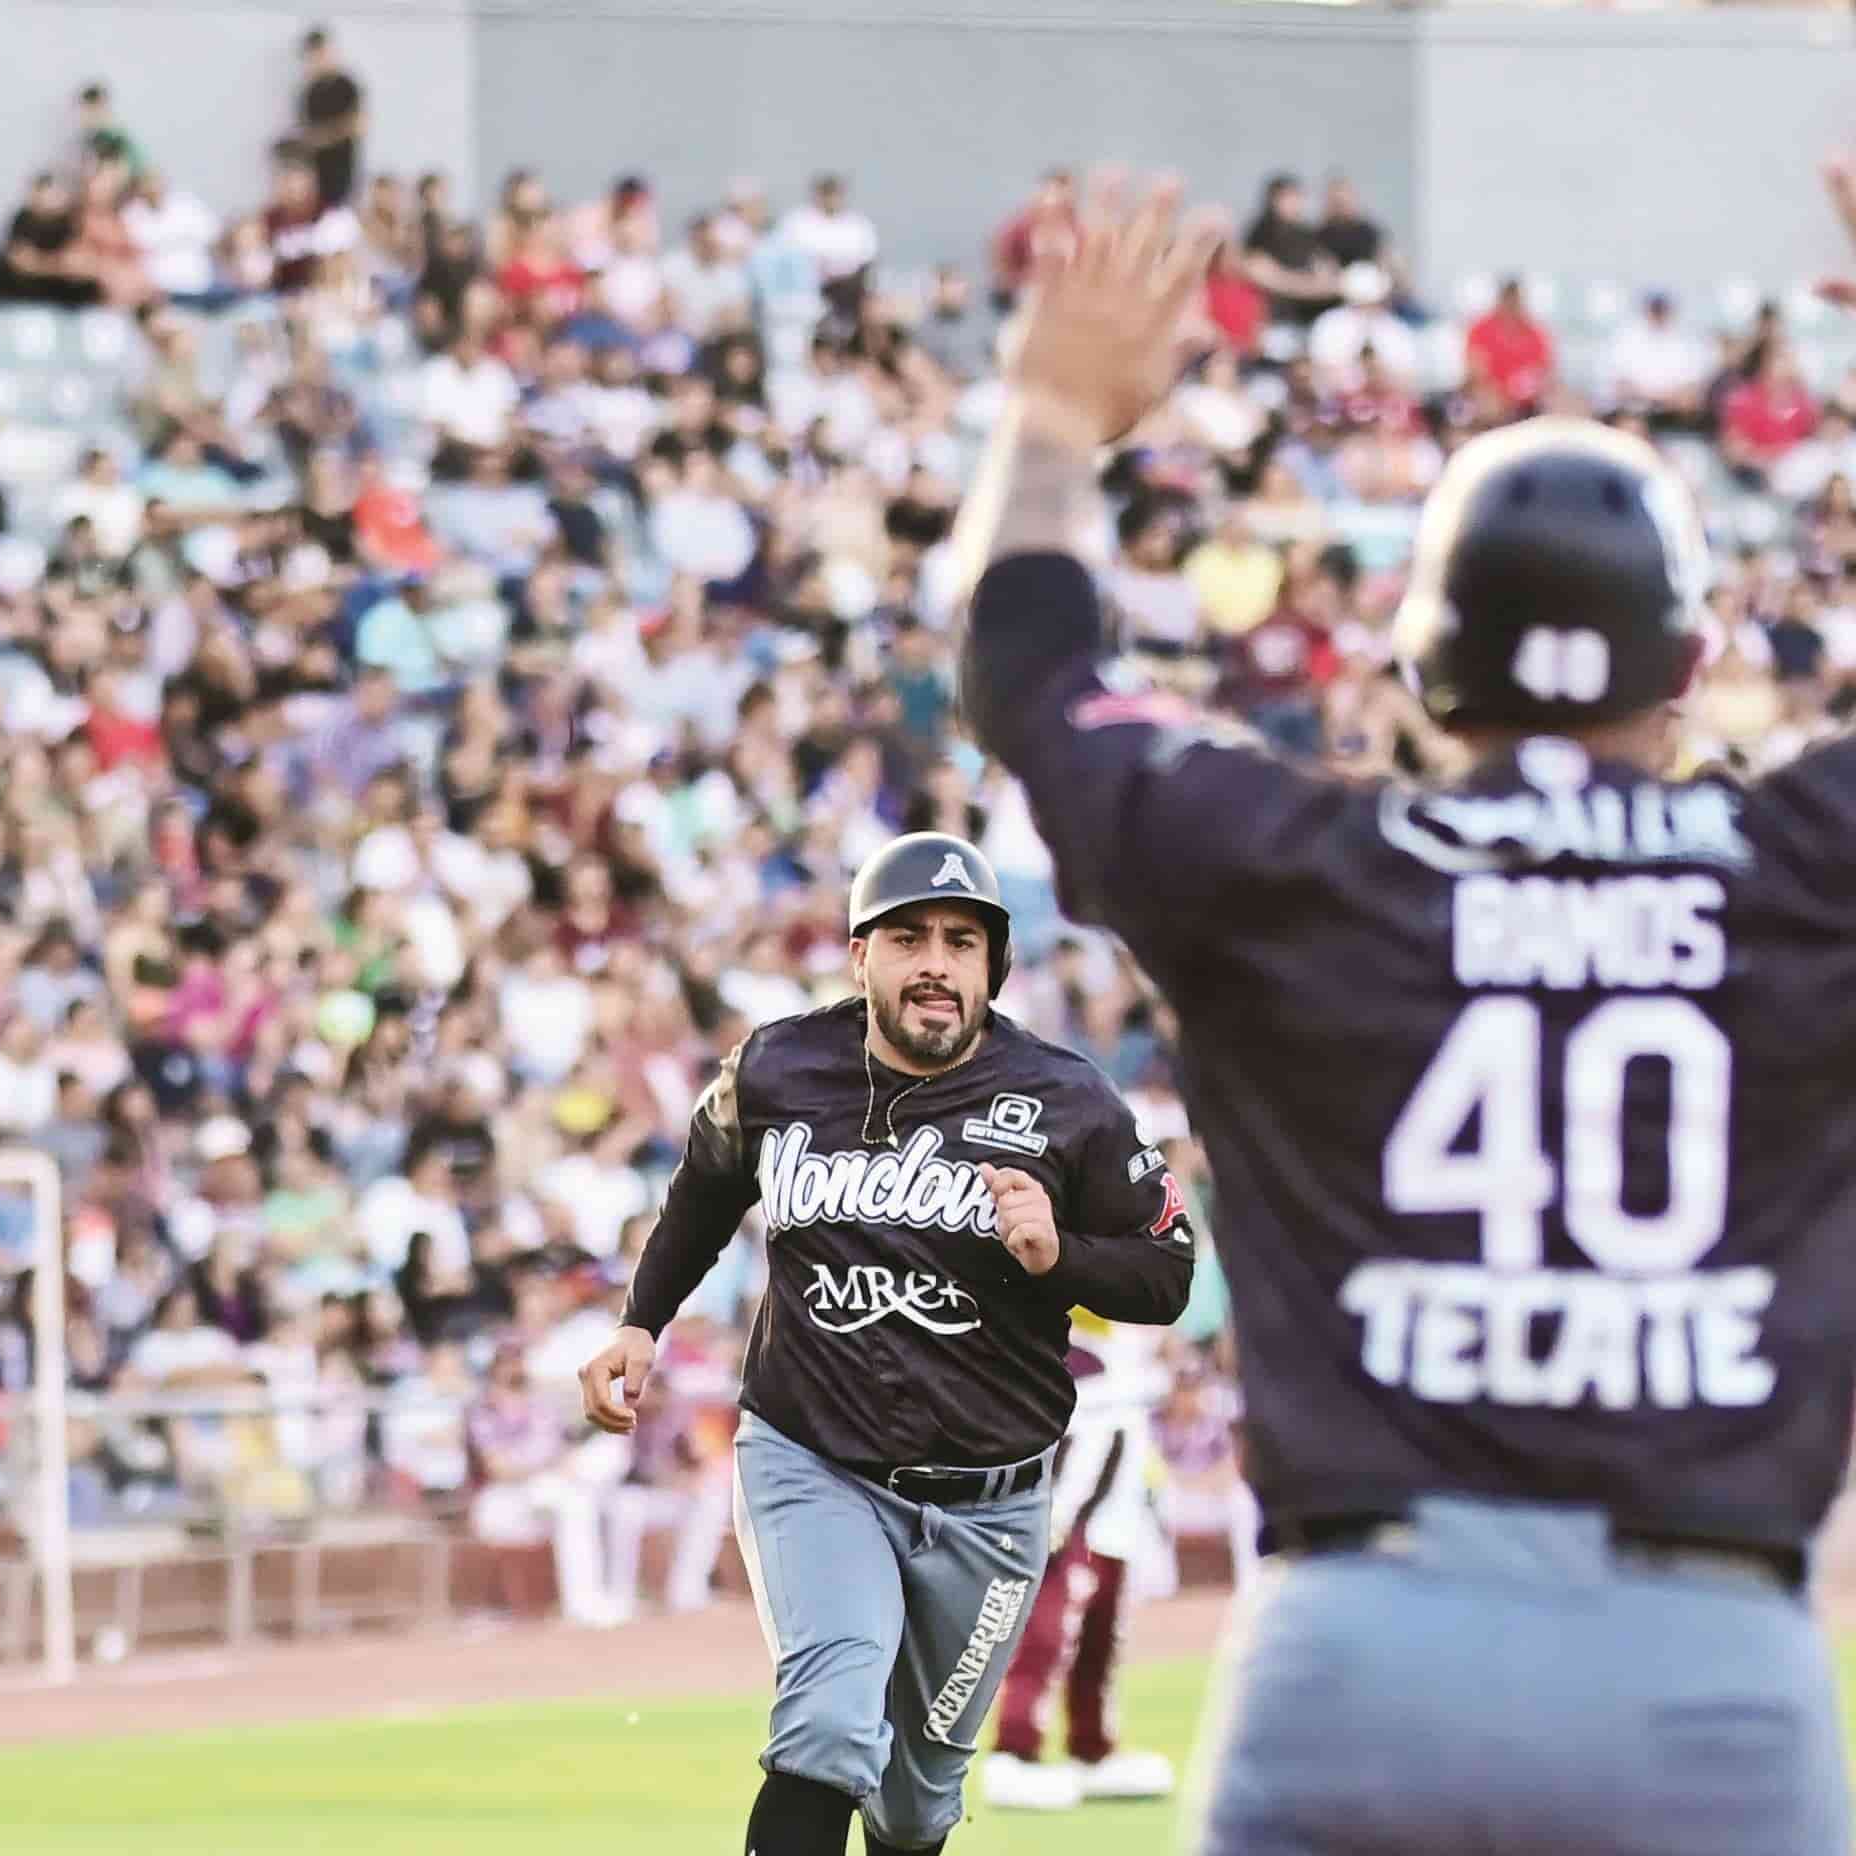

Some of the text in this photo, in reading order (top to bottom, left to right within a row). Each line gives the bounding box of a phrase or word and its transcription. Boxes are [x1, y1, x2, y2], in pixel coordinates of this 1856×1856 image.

[930, 852, 976, 892] A
[1452, 873, 1727, 989] RAMOS
[1382, 994, 1732, 1272] 40
[1339, 1257, 1776, 1408] TECATE
